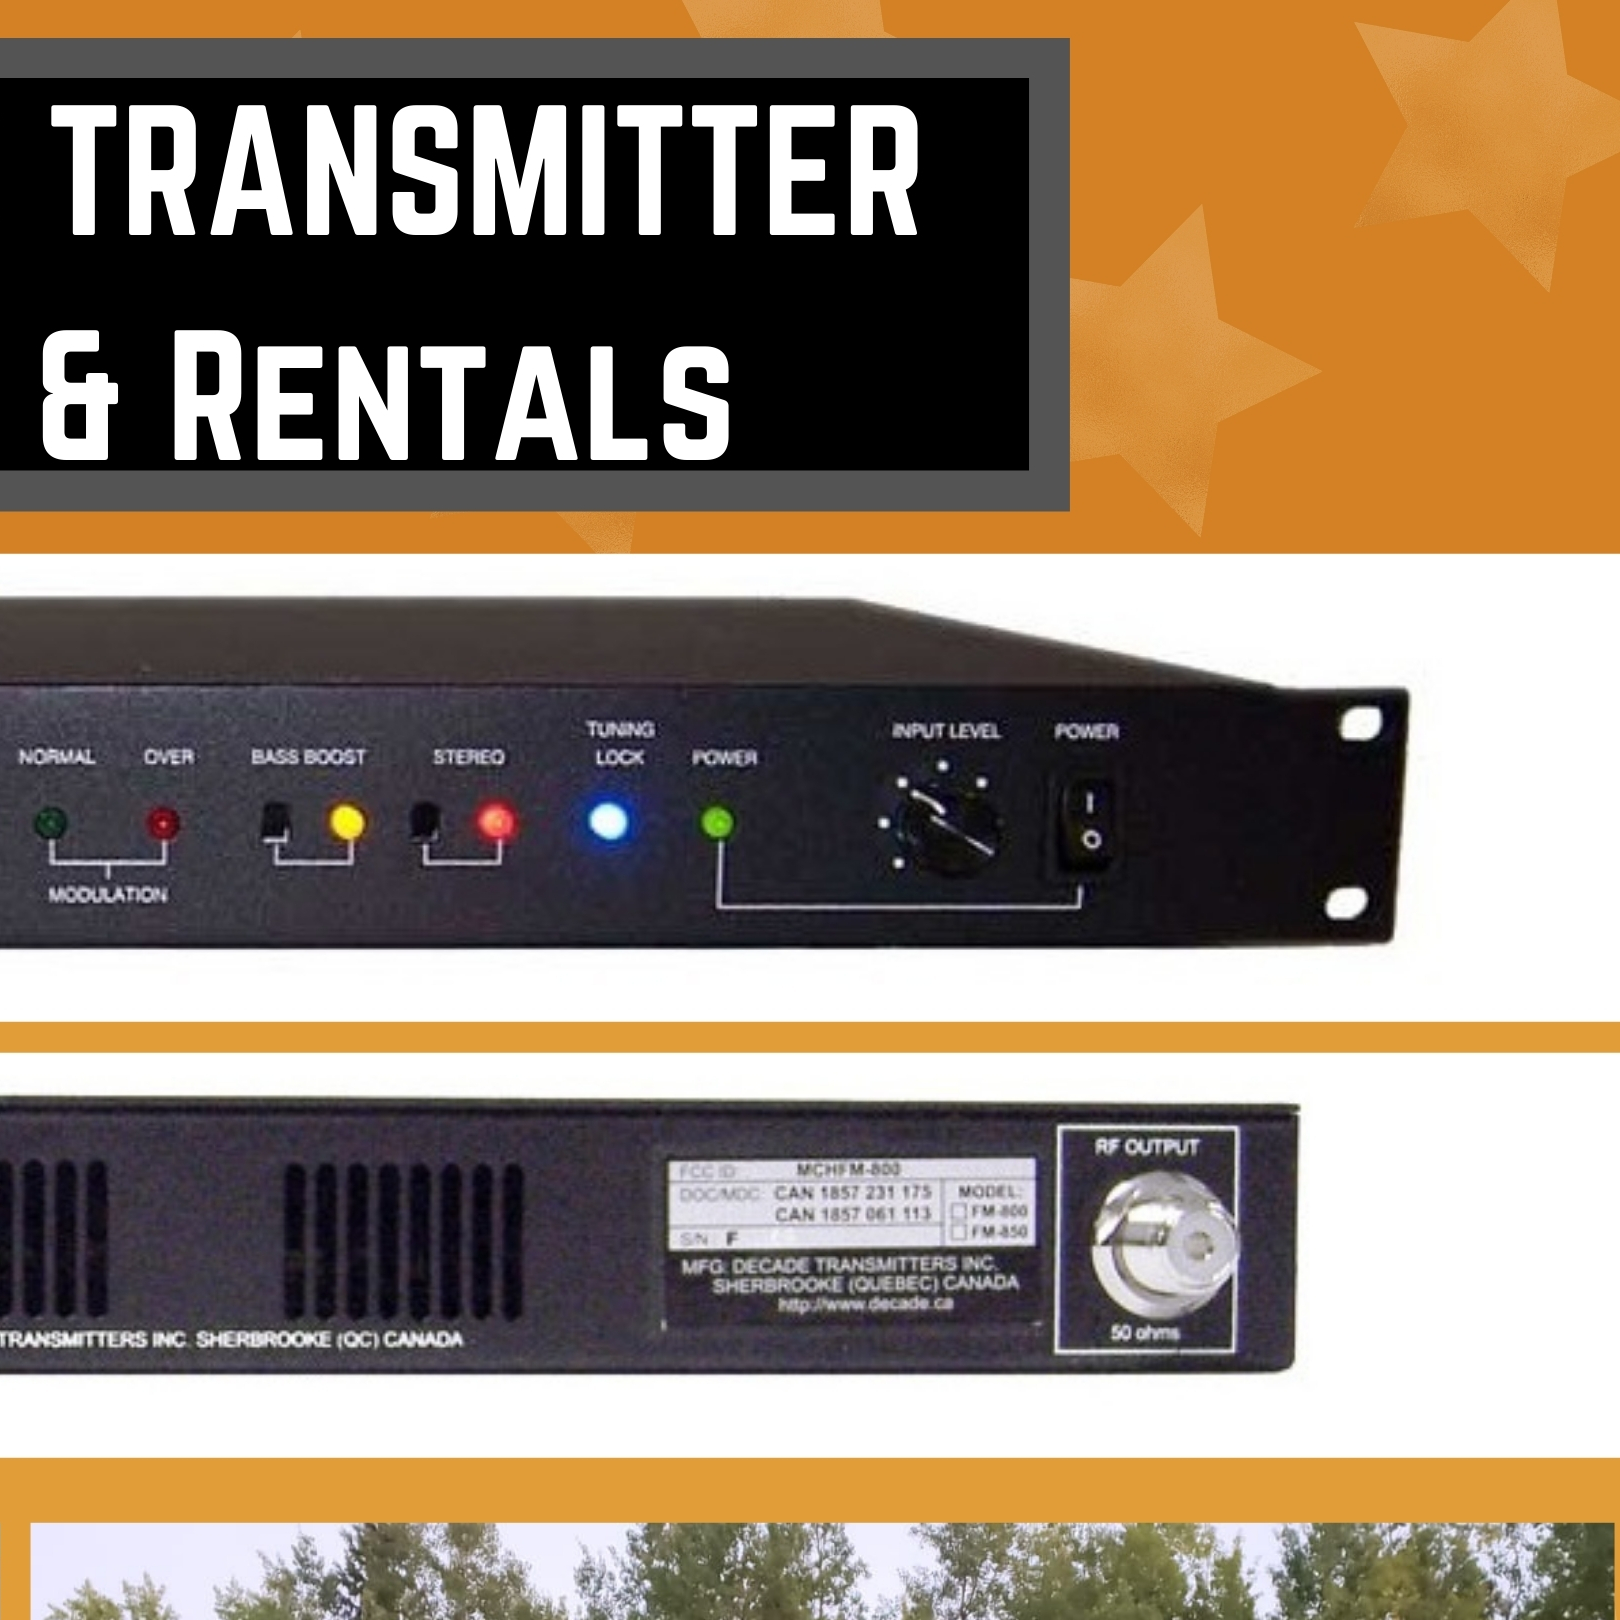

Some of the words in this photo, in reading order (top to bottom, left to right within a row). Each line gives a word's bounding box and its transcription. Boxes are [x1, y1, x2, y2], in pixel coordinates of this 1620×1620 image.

[587, 721, 655, 738] TUNING
[893, 723, 945, 739] INPUT
[949, 723, 1000, 739] LEVEL
[1055, 723, 1119, 739] POWER
[19, 748, 96, 765] NORMAL
[144, 749, 194, 765] OVER
[252, 749, 299, 764] BASS
[304, 749, 366, 765] BOOST
[434, 749, 505, 765] STEREO
[596, 749, 643, 765] LOCK
[693, 750, 757, 766] POWER
[49, 886, 167, 903] MODULATION
[1096, 1138, 1120, 1154] RF
[1125, 1138, 1200, 1156] OUTPUT
[680, 1166, 715, 1178] FCC
[774, 1186, 815, 1201] CAN
[821, 1186, 860, 1201] 1857
[866, 1186, 895, 1200] 231
[902, 1185, 932, 1200] 175
[959, 1186, 1022, 1198] MODEL:
[775, 1207, 815, 1223] CAN
[821, 1207, 860, 1223] 1857
[866, 1207, 896, 1223] 061
[903, 1207, 932, 1221] 113
[971, 1205, 1029, 1219] FM-800
[725, 1232, 739, 1245] F
[732, 1258, 810, 1273] DECADE
[815, 1256, 958, 1272] TRANSMITTERS
[962, 1256, 1000, 1271] INC.
[712, 1277, 844, 1293] SHERBROOKE
[848, 1277, 940, 1293] (QUEBEC)
[944, 1276, 1020, 1291] CANADA
[778, 1296, 954, 1314] http://www.decade.ca
[196, 1330, 331, 1348] SHERBROOKE
[337, 1331, 379, 1349] (QC)
[383, 1331, 463, 1348] CANADA
[1112, 1325, 1131, 1340] 50
[1135, 1325, 1180, 1341] ohms
